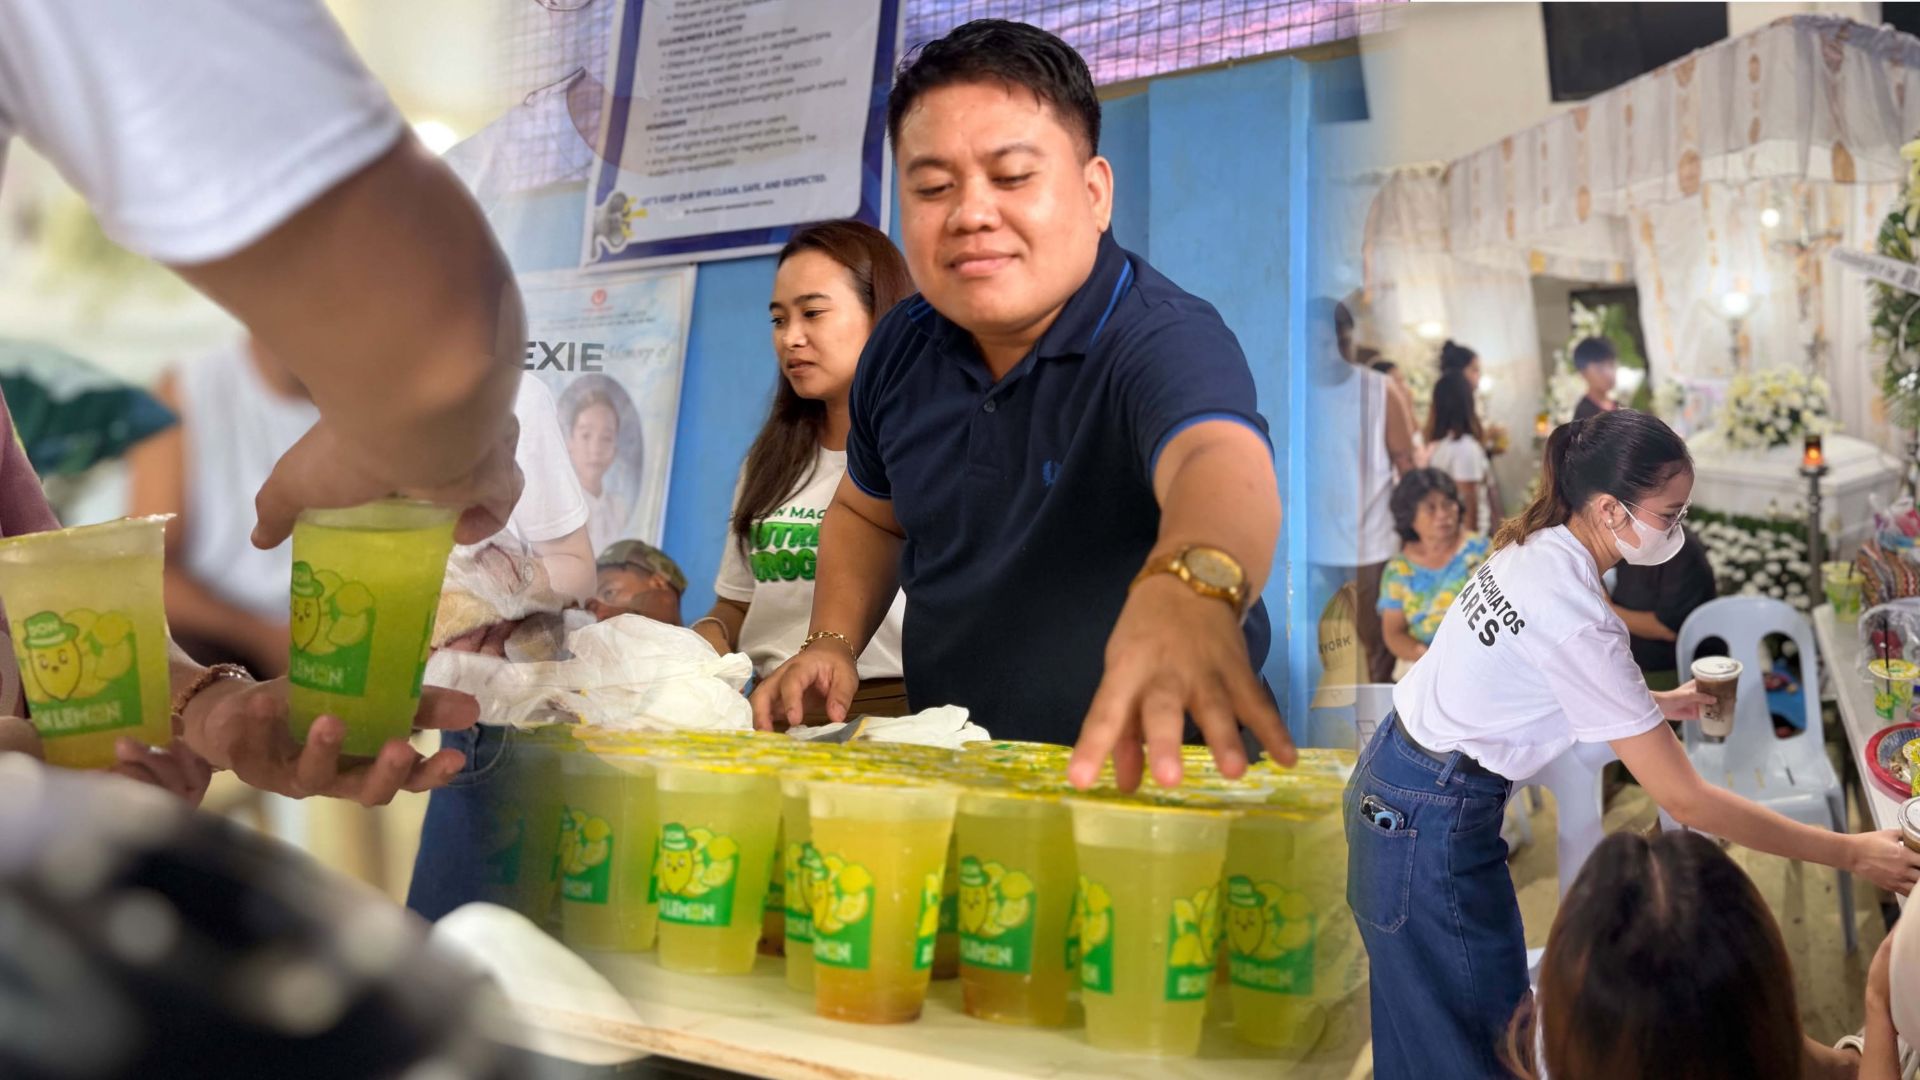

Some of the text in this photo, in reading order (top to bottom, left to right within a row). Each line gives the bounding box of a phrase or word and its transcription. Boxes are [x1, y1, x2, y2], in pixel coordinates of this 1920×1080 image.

[659, 193, 678, 204] KEEP
[679, 190, 694, 201] OUR
[695, 187, 713, 199] GYM
[764, 179, 781, 190] AND
[749, 549, 817, 582] ROG
